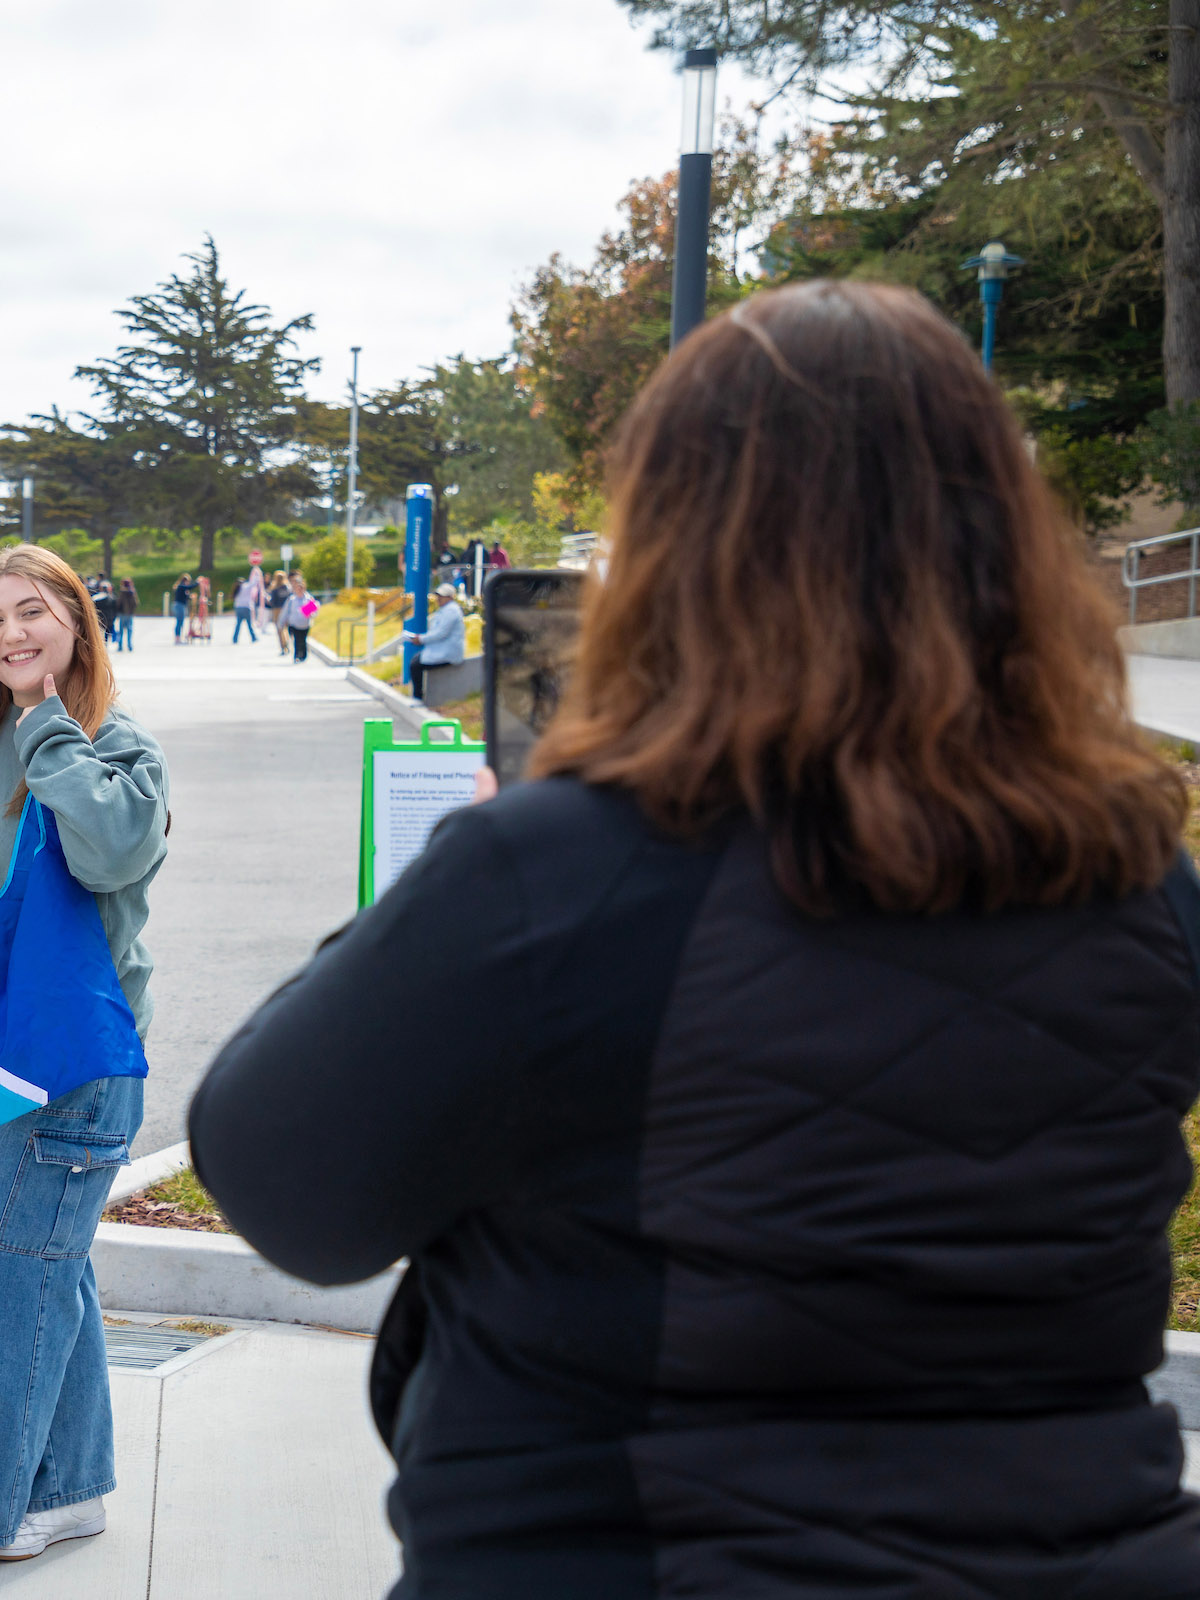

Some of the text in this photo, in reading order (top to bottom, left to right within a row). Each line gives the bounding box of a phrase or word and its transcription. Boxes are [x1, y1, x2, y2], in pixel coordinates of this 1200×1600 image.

[411, 516, 423, 572] Emergency
[390, 771, 412, 779] Notice
[412, 771, 419, 779] of
[419, 771, 441, 780] Filming
[443, 771, 453, 779] and
